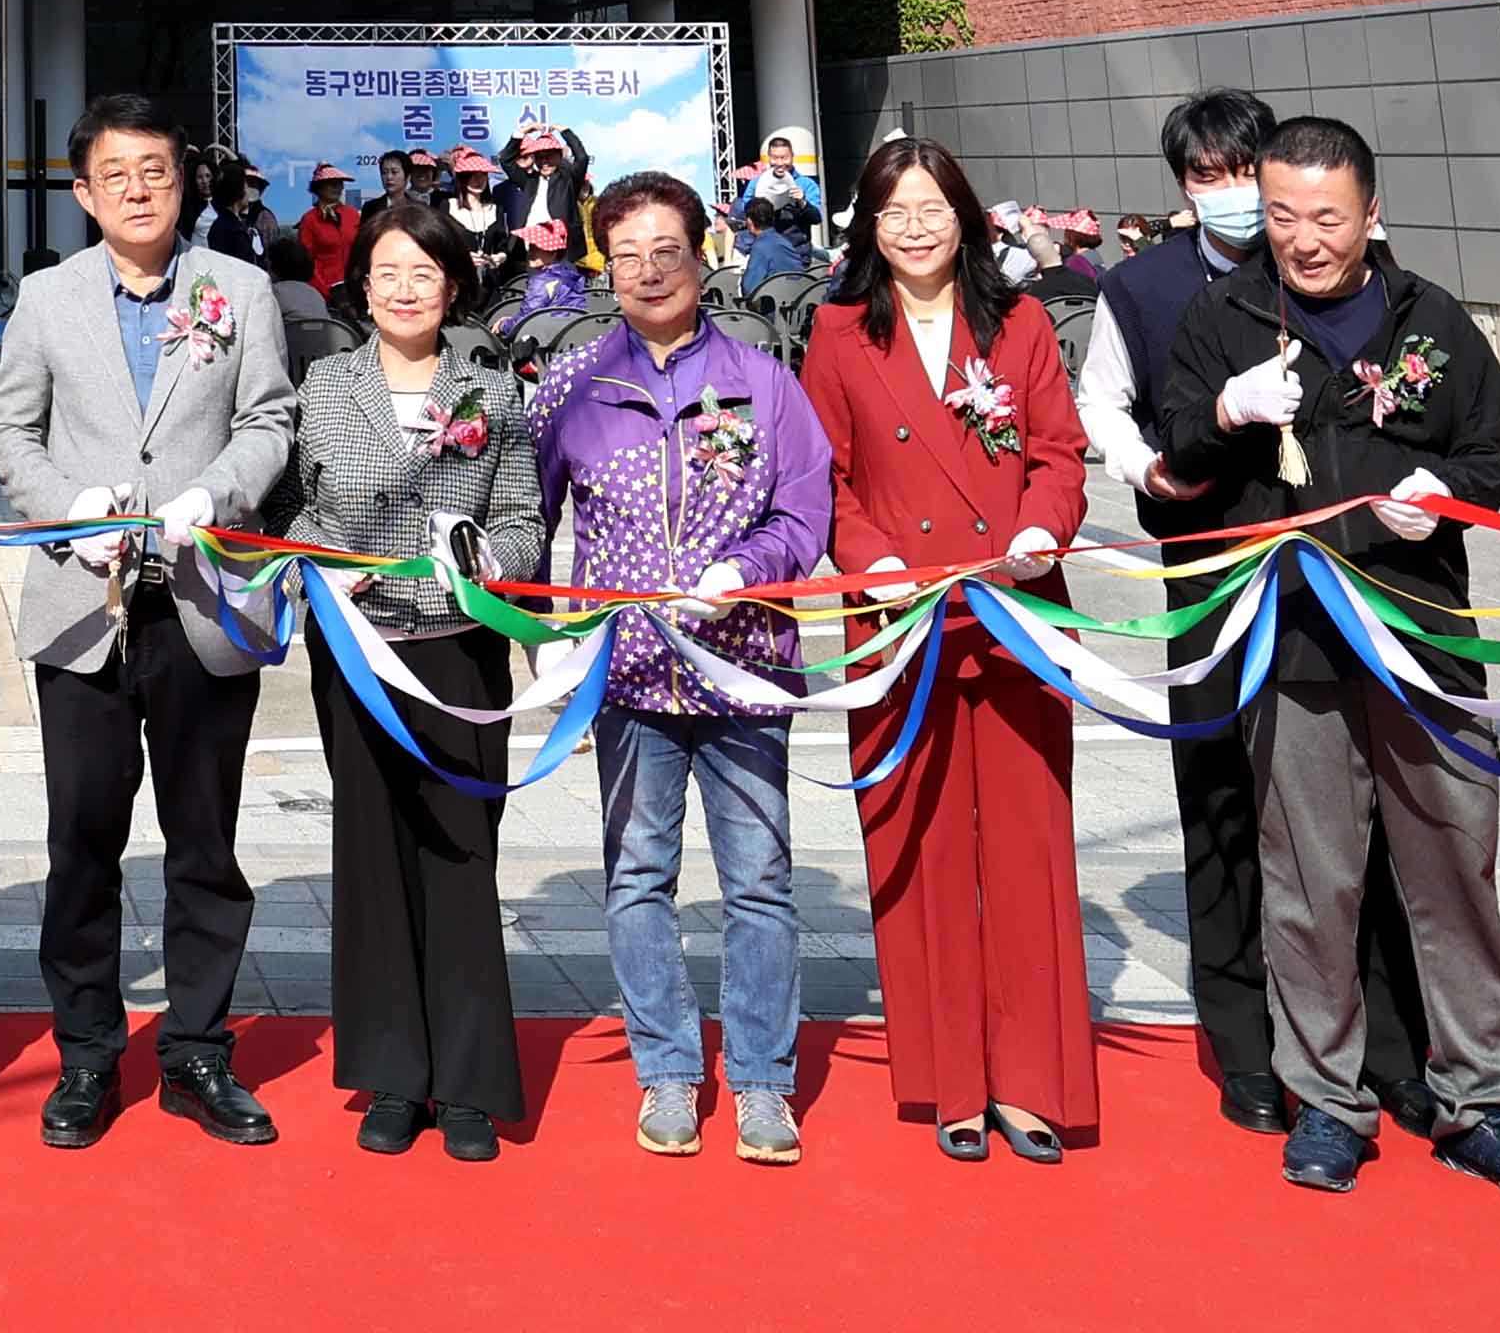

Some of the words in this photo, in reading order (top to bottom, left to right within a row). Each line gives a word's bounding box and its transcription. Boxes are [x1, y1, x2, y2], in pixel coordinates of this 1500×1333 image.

[305, 70, 541, 97] 동구한마음종합복지관
[548, 70, 640, 96] 증축공사
[356, 155, 381, 166] 202
